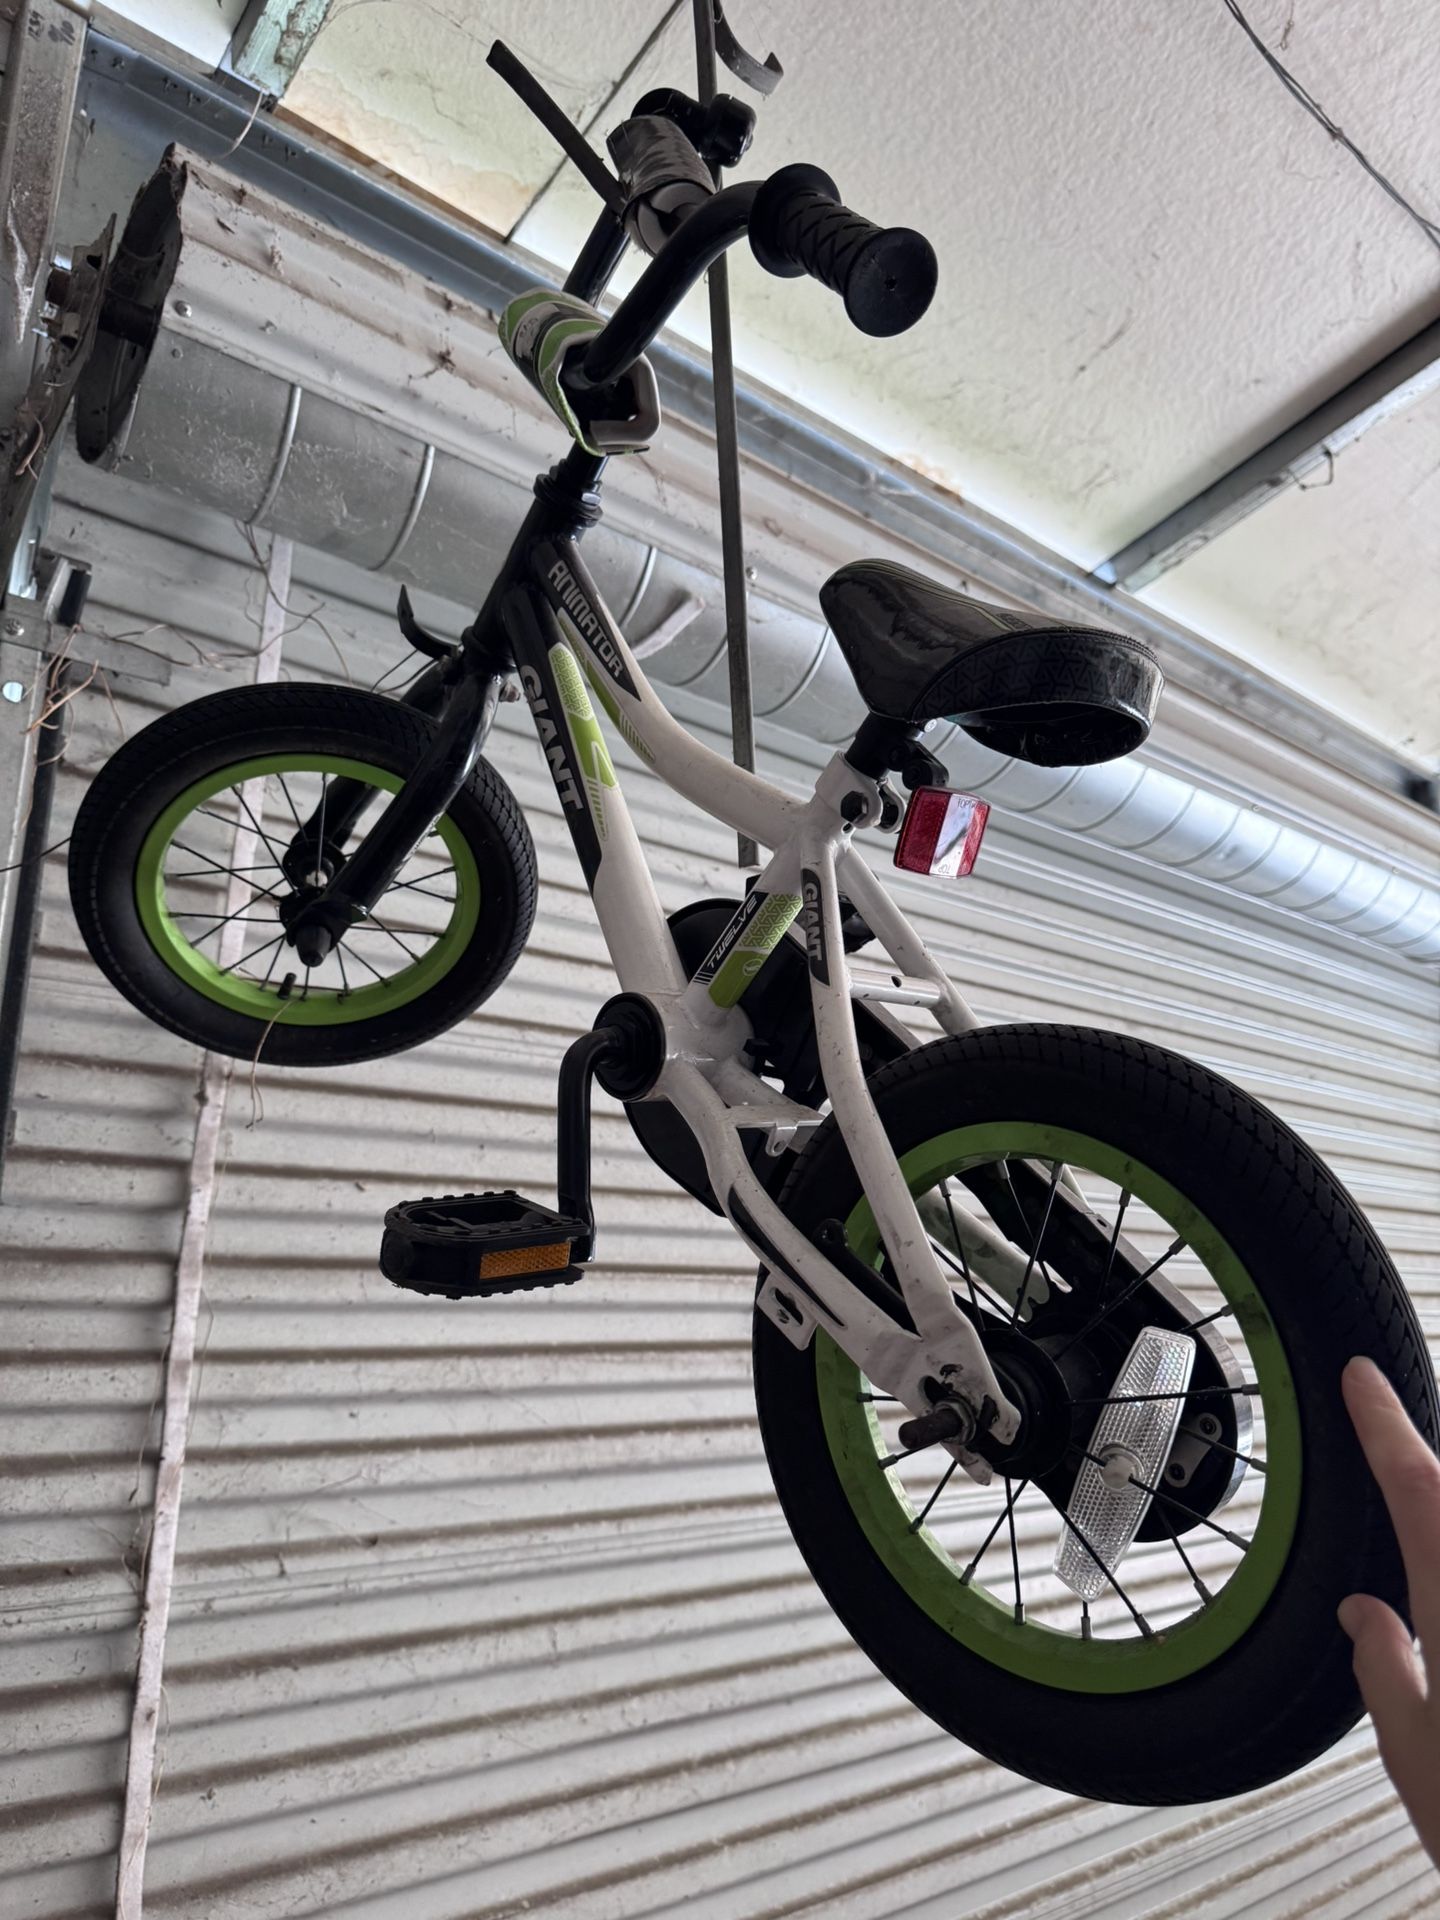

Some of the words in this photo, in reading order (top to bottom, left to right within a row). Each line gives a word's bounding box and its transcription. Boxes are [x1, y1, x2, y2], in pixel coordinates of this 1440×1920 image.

[548, 559, 625, 678] ANIMATOR
[520, 664, 584, 811] GIANT
[707, 895, 758, 968] TWELVE
[803, 882, 823, 961] GIANT
